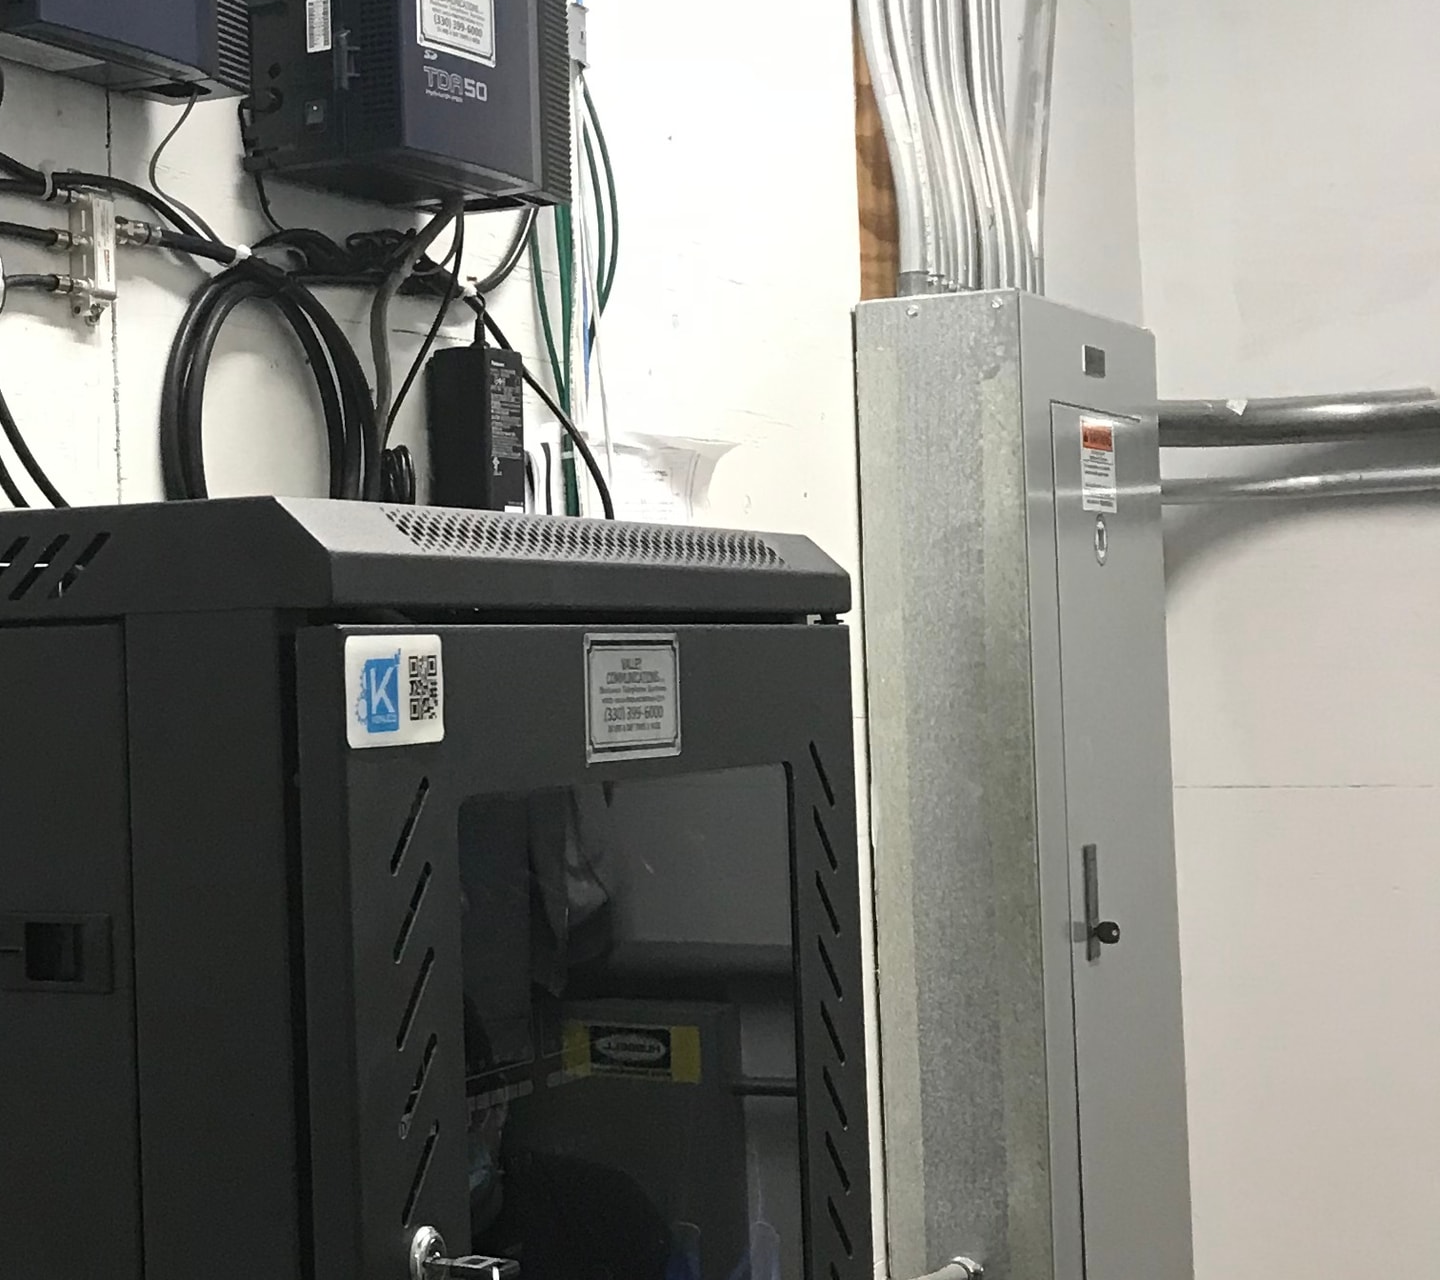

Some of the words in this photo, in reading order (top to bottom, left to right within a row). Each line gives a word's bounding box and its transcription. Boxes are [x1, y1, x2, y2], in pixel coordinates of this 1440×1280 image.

[423, 66, 487, 101] TDA50
[604, 706, 625, 722] (330)
[627, 705, 664, 720] 399-6000
